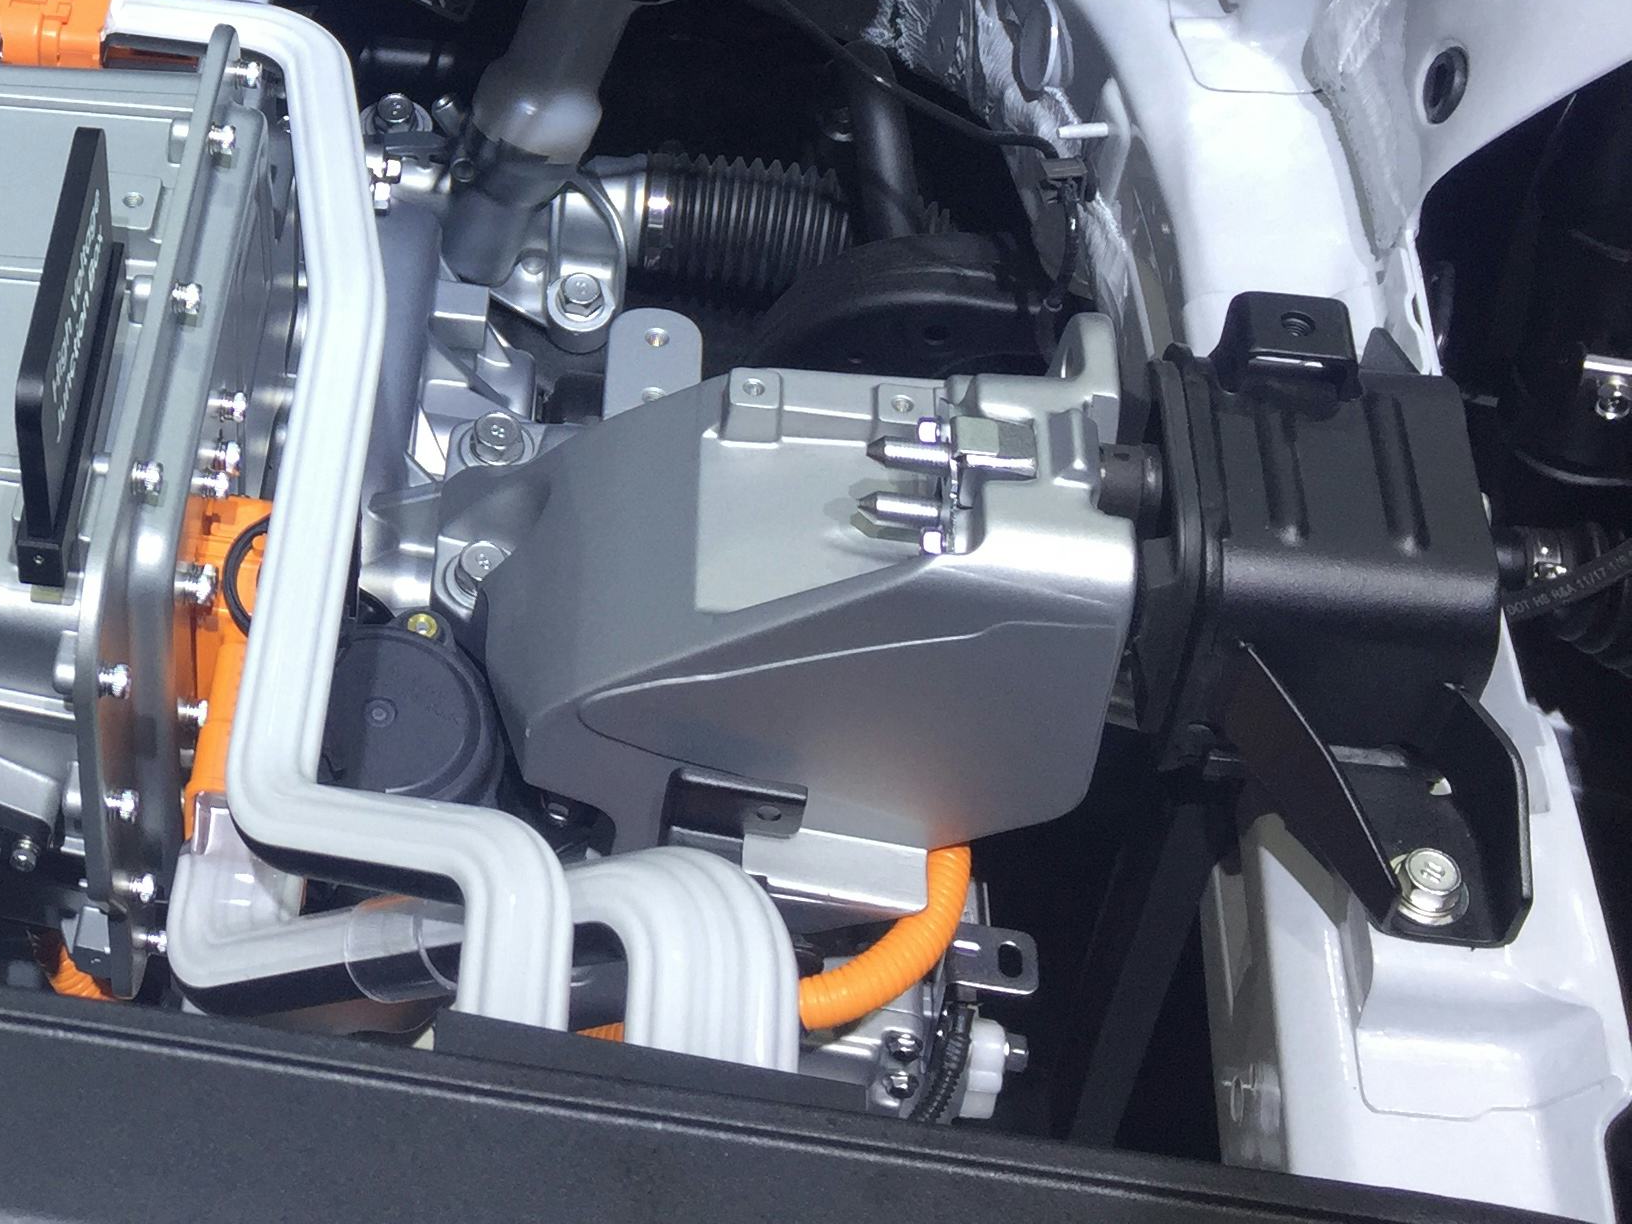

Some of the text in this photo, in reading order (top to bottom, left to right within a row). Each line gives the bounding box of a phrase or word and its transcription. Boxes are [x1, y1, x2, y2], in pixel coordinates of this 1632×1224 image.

[52, 188, 101, 404] High Voltage
[56, 224, 104, 444] Junction Box
